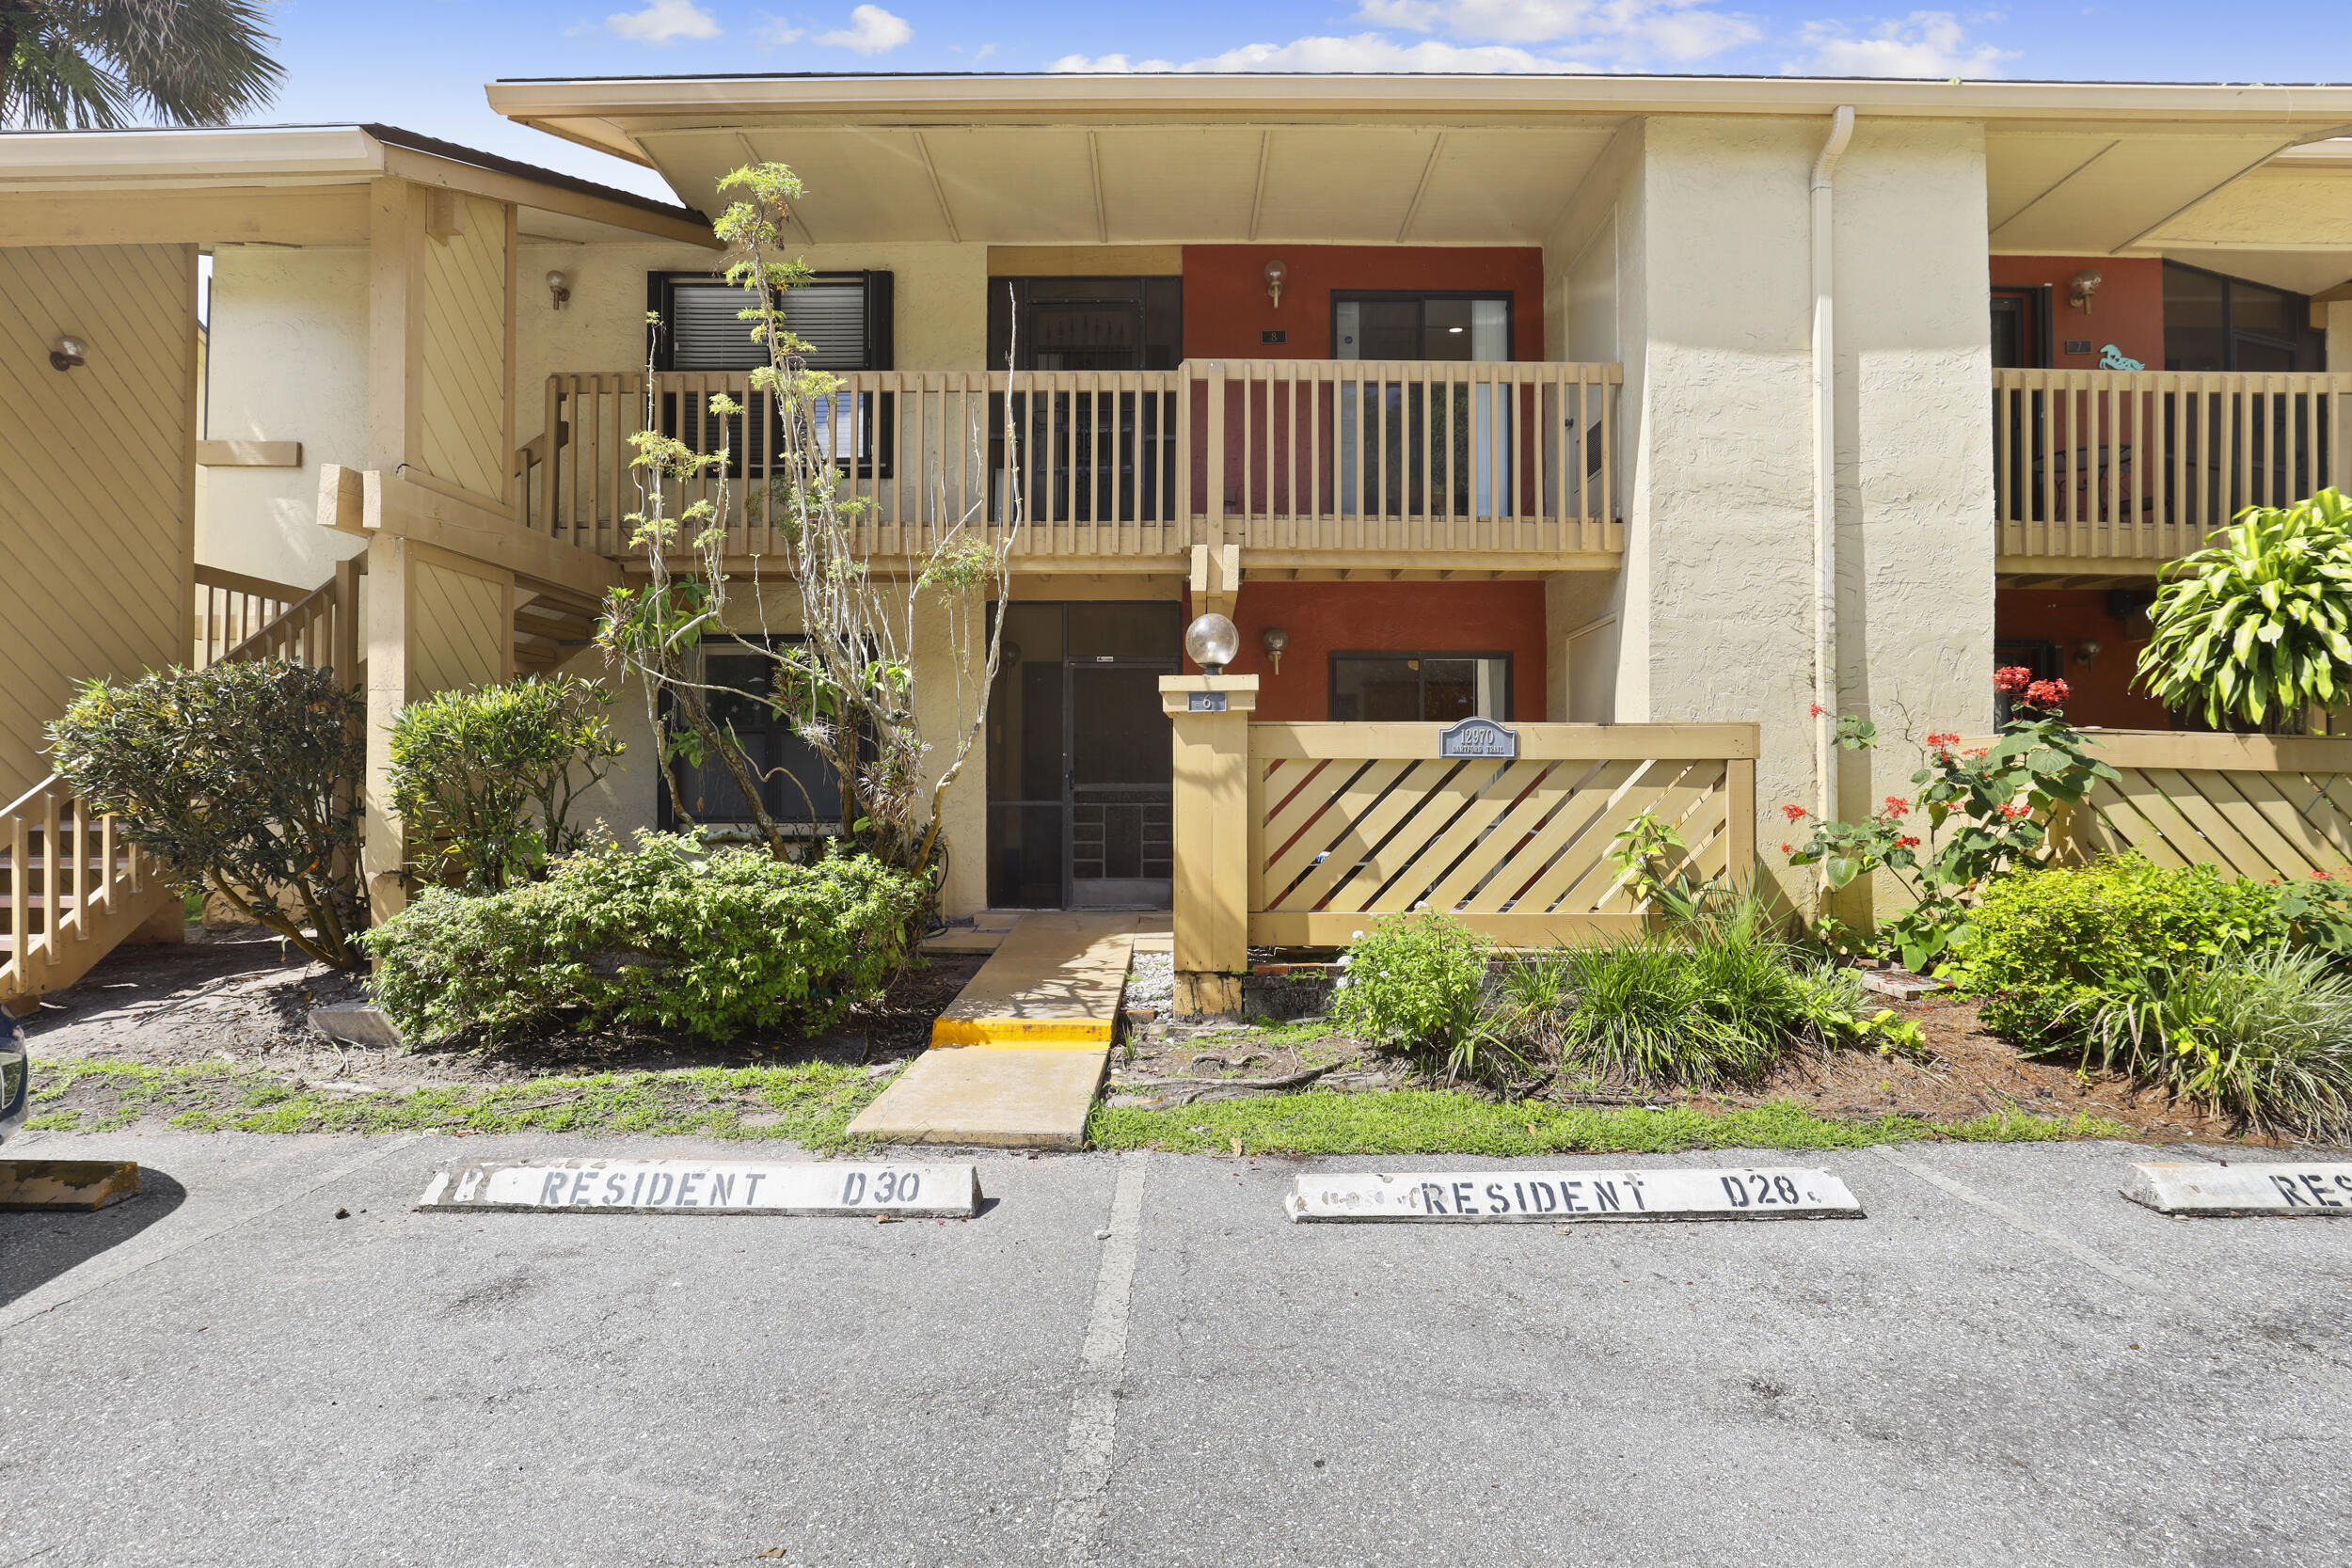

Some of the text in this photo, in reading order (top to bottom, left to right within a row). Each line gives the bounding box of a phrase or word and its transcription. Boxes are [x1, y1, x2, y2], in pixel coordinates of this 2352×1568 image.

[1271, 331, 1278, 342] 8
[1202, 693, 1211, 708] 6
[1460, 728, 1495, 744] 12970
[539, 1171, 920, 1207] RESIDENT D30
[1420, 1174, 1800, 1214] RESIDENT D28
